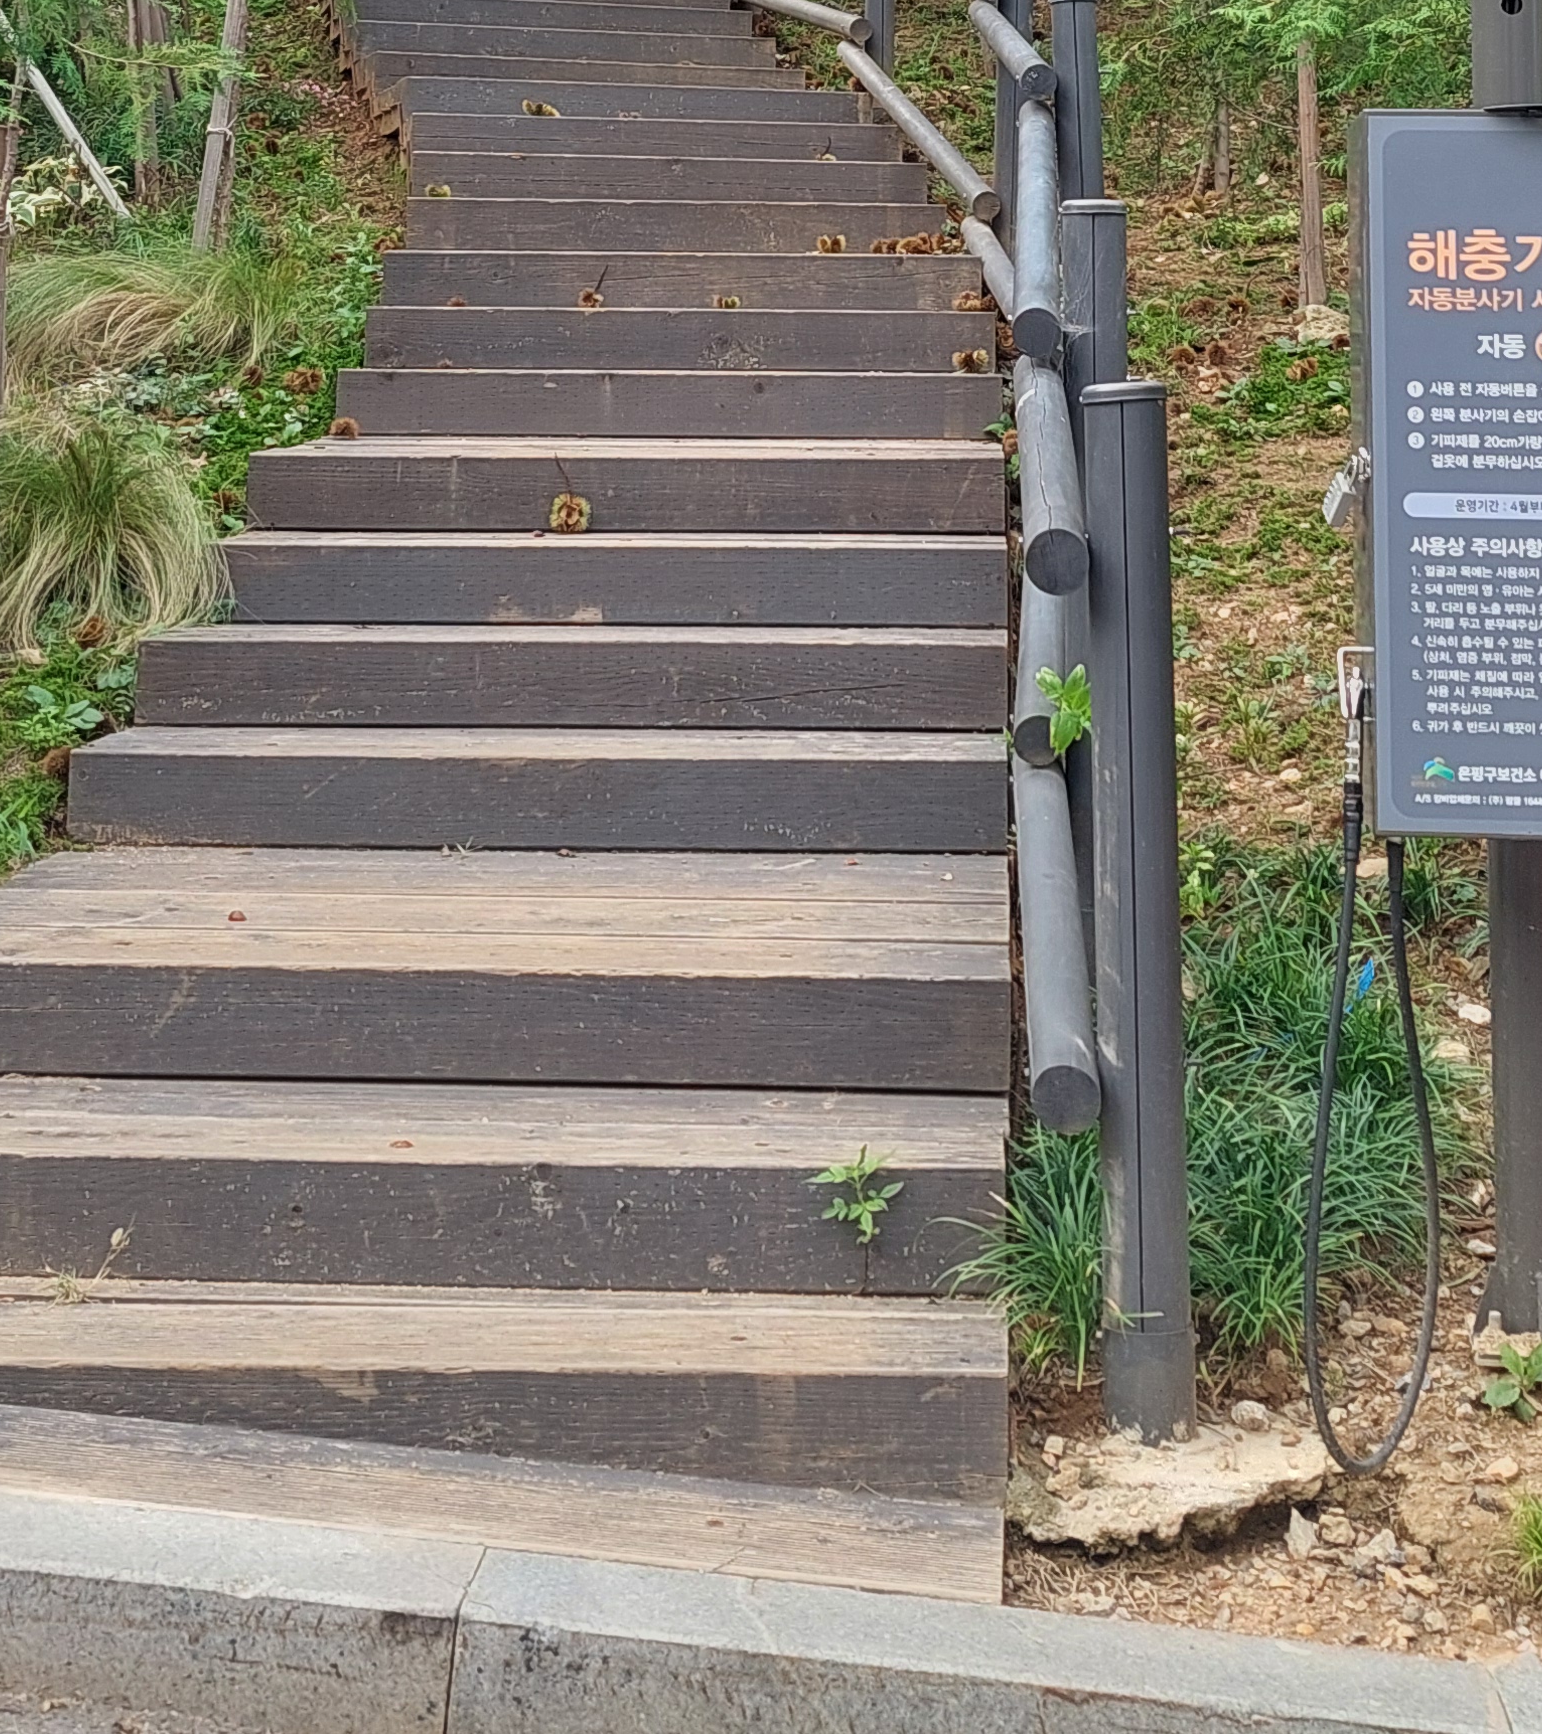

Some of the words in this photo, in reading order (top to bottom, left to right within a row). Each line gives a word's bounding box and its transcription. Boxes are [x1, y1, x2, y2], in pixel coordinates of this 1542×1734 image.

[1408, 287, 1523, 313] 자동분사기
[1476, 333, 1526, 359] 자동
[1430, 382, 1455, 397] 사용
[1459, 382, 1472, 396] 전
[1475, 382, 1538, 398] 자동버튼을
[1430, 408, 1455, 423] 왼쪽
[1459, 408, 1509, 423] 분사기의
[1431, 434, 1481, 449] 기피제를
[1484, 434, 1542, 450] 20cm가량
[1455, 499, 1500, 513] 운영기간
[1410, 536, 1465, 556] 사용상
[1424, 565, 1457, 578] 얼굴과
[1460, 566, 1493, 579] 목에는
[1496, 566, 1540, 579] 사용하지
[1446, 583, 1479, 596] 미만의
[1441, 601, 1463, 614] 다리
[1466, 602, 1477, 615] 등
[1504, 603, 1535, 616] 부위나
[1423, 617, 1455, 630] 거리를
[1459, 617, 1481, 630] 두고
[1497, 636, 1509, 649] 수
[1512, 637, 1535, 650] 있는
[1512, 671, 1535, 684] 따라
[1426, 685, 1449, 698] 사용
[1453, 685, 1465, 699] 시
[1427, 720, 1449, 733] 귀가
[1452, 720, 1464, 734] 후
[1466, 721, 1500, 734] 반드시
[1458, 765, 1537, 783] 은평구보건소
